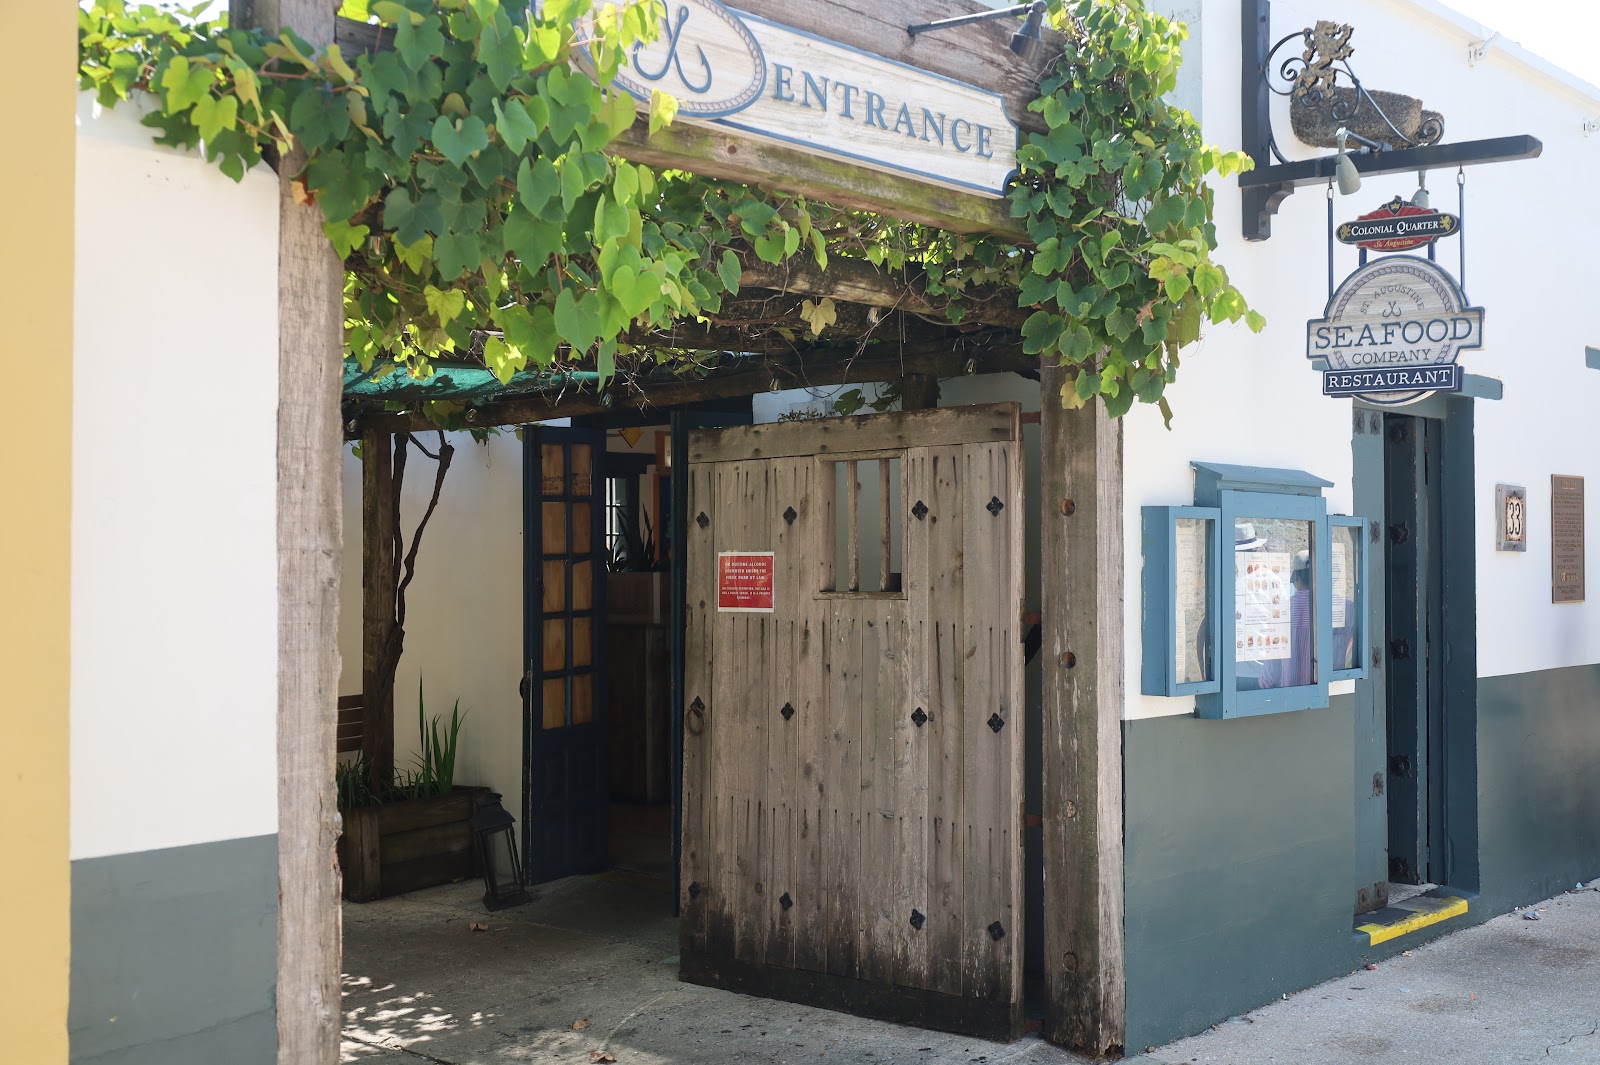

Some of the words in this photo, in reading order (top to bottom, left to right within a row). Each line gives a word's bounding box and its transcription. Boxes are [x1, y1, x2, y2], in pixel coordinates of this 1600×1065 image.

[772, 62, 994, 159] ENTRANCE
[1351, 224, 1394, 236] COLONIAL
[1396, 220, 1439, 235] QUARTER
[1384, 239, 1414, 248] Augustine
[1360, 301, 1373, 315] ST.
[1374, 284, 1425, 311] AUGUSTINE
[1315, 317, 1473, 350] SEAFOOD
[1352, 349, 1432, 365] COMPANY
[1328, 369, 1450, 388] RESTAURANT
[1508, 501, 1521, 535] 33
